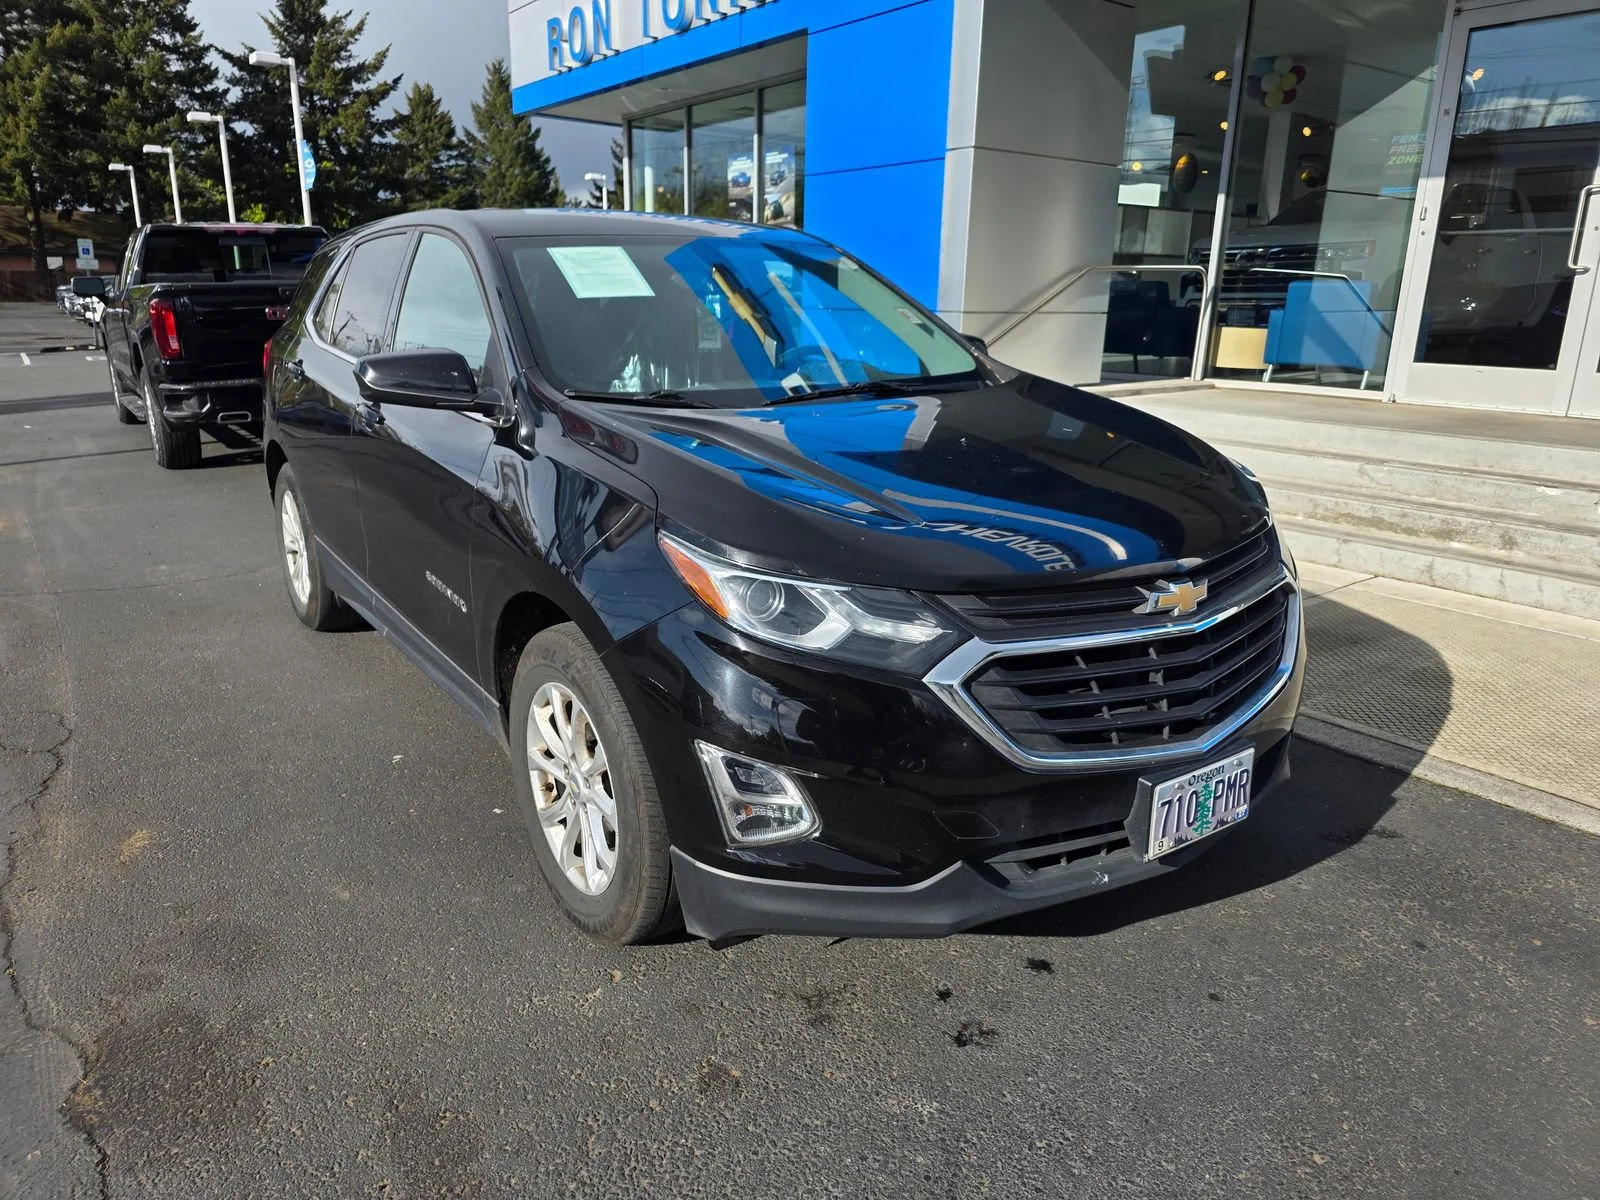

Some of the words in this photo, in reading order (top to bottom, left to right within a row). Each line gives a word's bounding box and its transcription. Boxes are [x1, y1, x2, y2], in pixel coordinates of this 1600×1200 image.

[547, 0, 613, 71] RON
[1389, 143, 1425, 153] FREE
[1386, 154, 1423, 165] ZONE
[1188, 764, 1225, 786] Oregon
[1158, 789, 1198, 839] 710
[1210, 767, 1250, 817] PMR
[1157, 840, 1164, 851] 9
